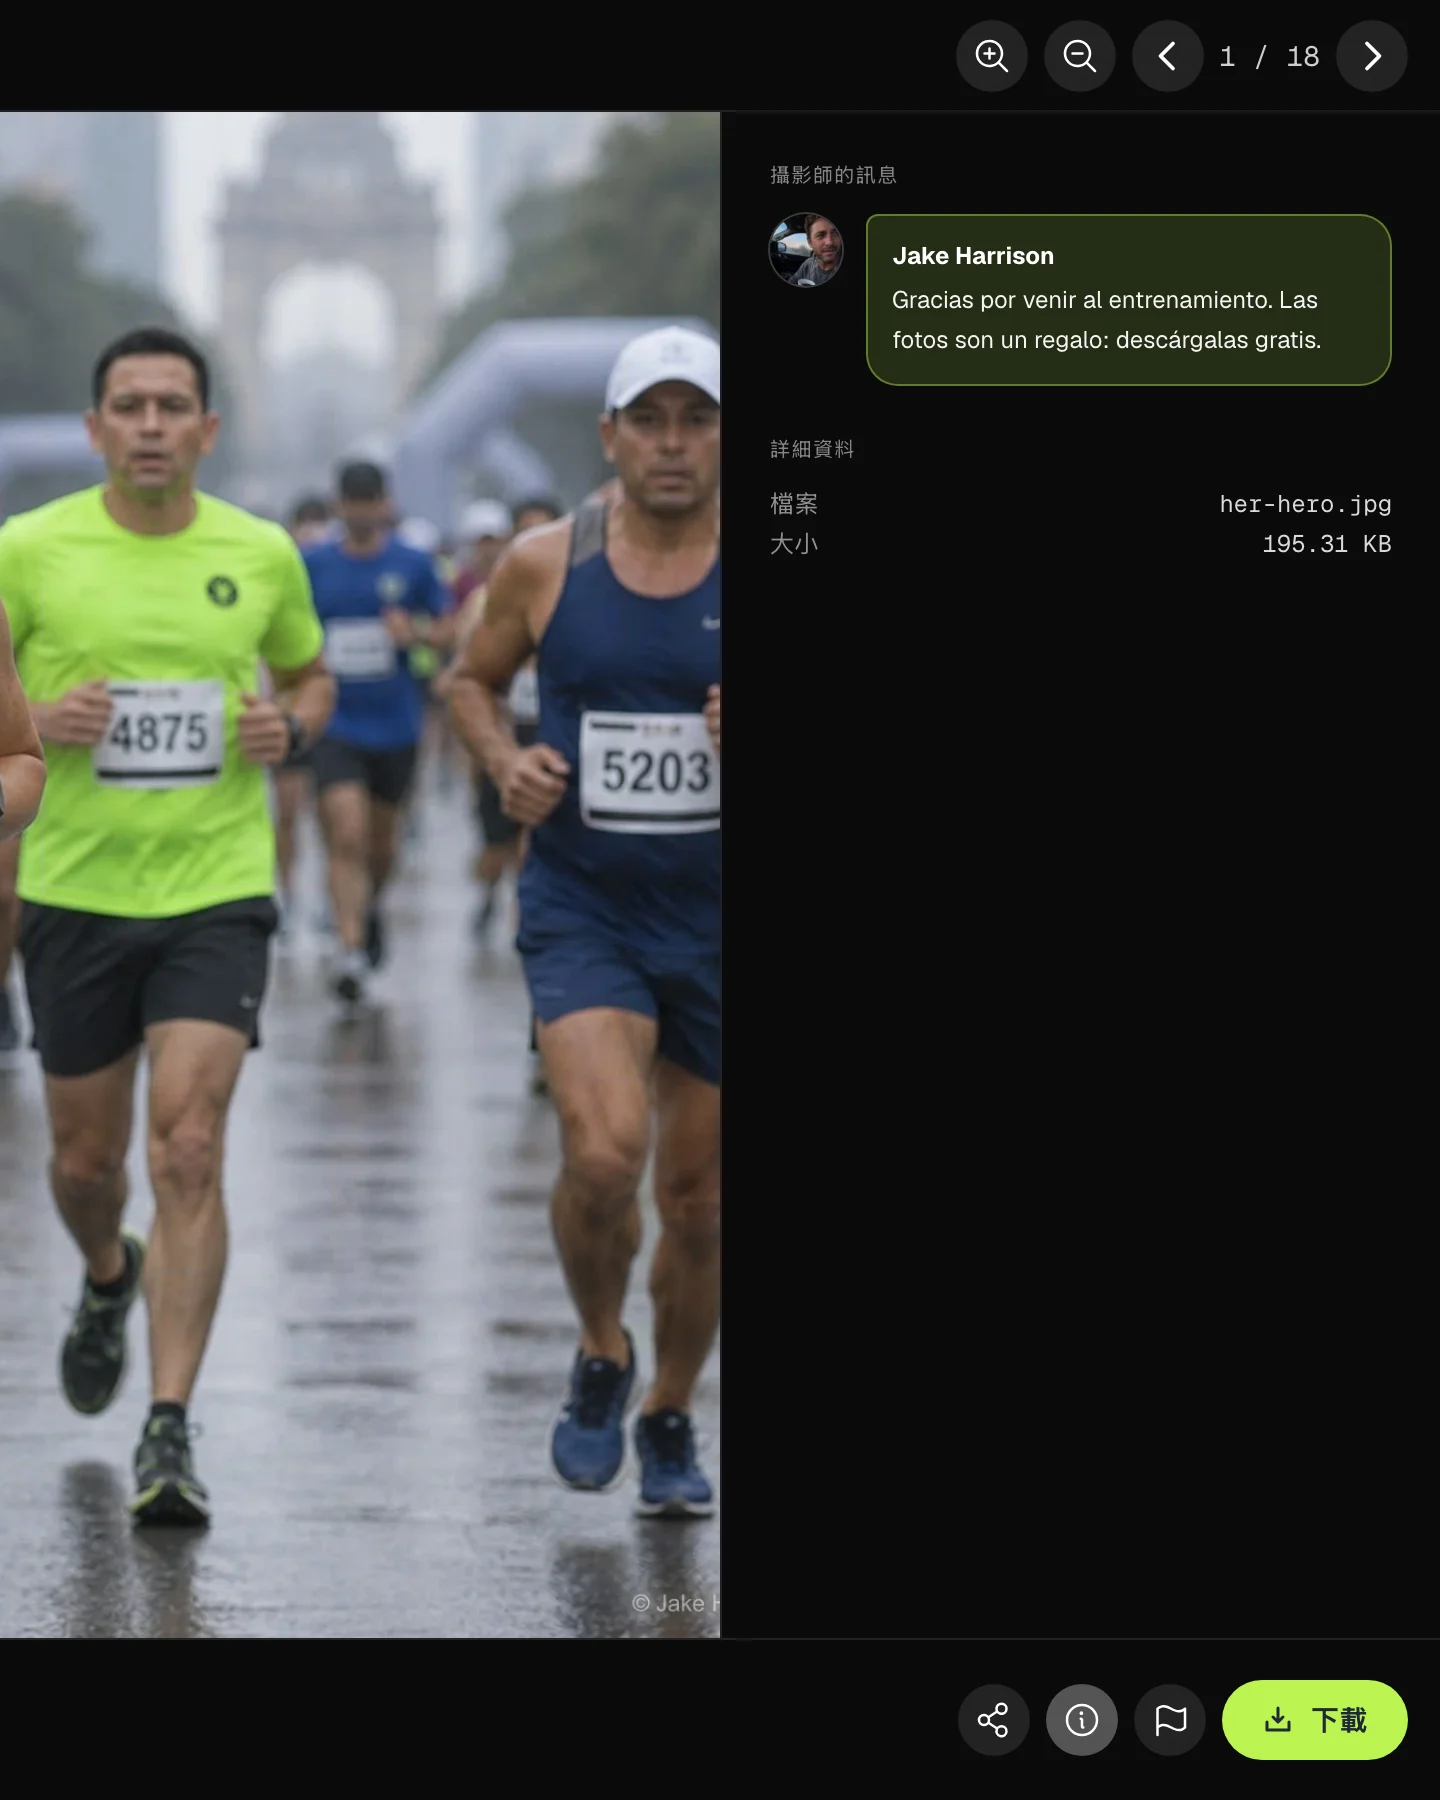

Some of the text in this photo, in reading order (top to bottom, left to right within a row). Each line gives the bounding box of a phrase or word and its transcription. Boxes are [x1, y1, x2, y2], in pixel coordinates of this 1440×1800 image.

[1220, 44, 1320, 70] 1 / 18
[770, 164, 897, 185] 攝影師的訊息
[892, 245, 1054, 266] Jake Harrison
[892, 289, 1318, 314] Gracias por venir al entrenamiento. Las
[892, 329, 1321, 353] fotos son un regalo: descárgalas gratis.
[770, 438, 855, 459] 詳細資料
[770, 491, 818, 515] 檔案
[1220, 493, 1392, 517] her-hero.jpg
[770, 531, 819, 555] 大小
[1263, 533, 1392, 554] 195.31 KB
[109, 713, 208, 754] 4875
[602, 749, 710, 793] 5203
[1311, 1706, 1368, 1734] 下載
